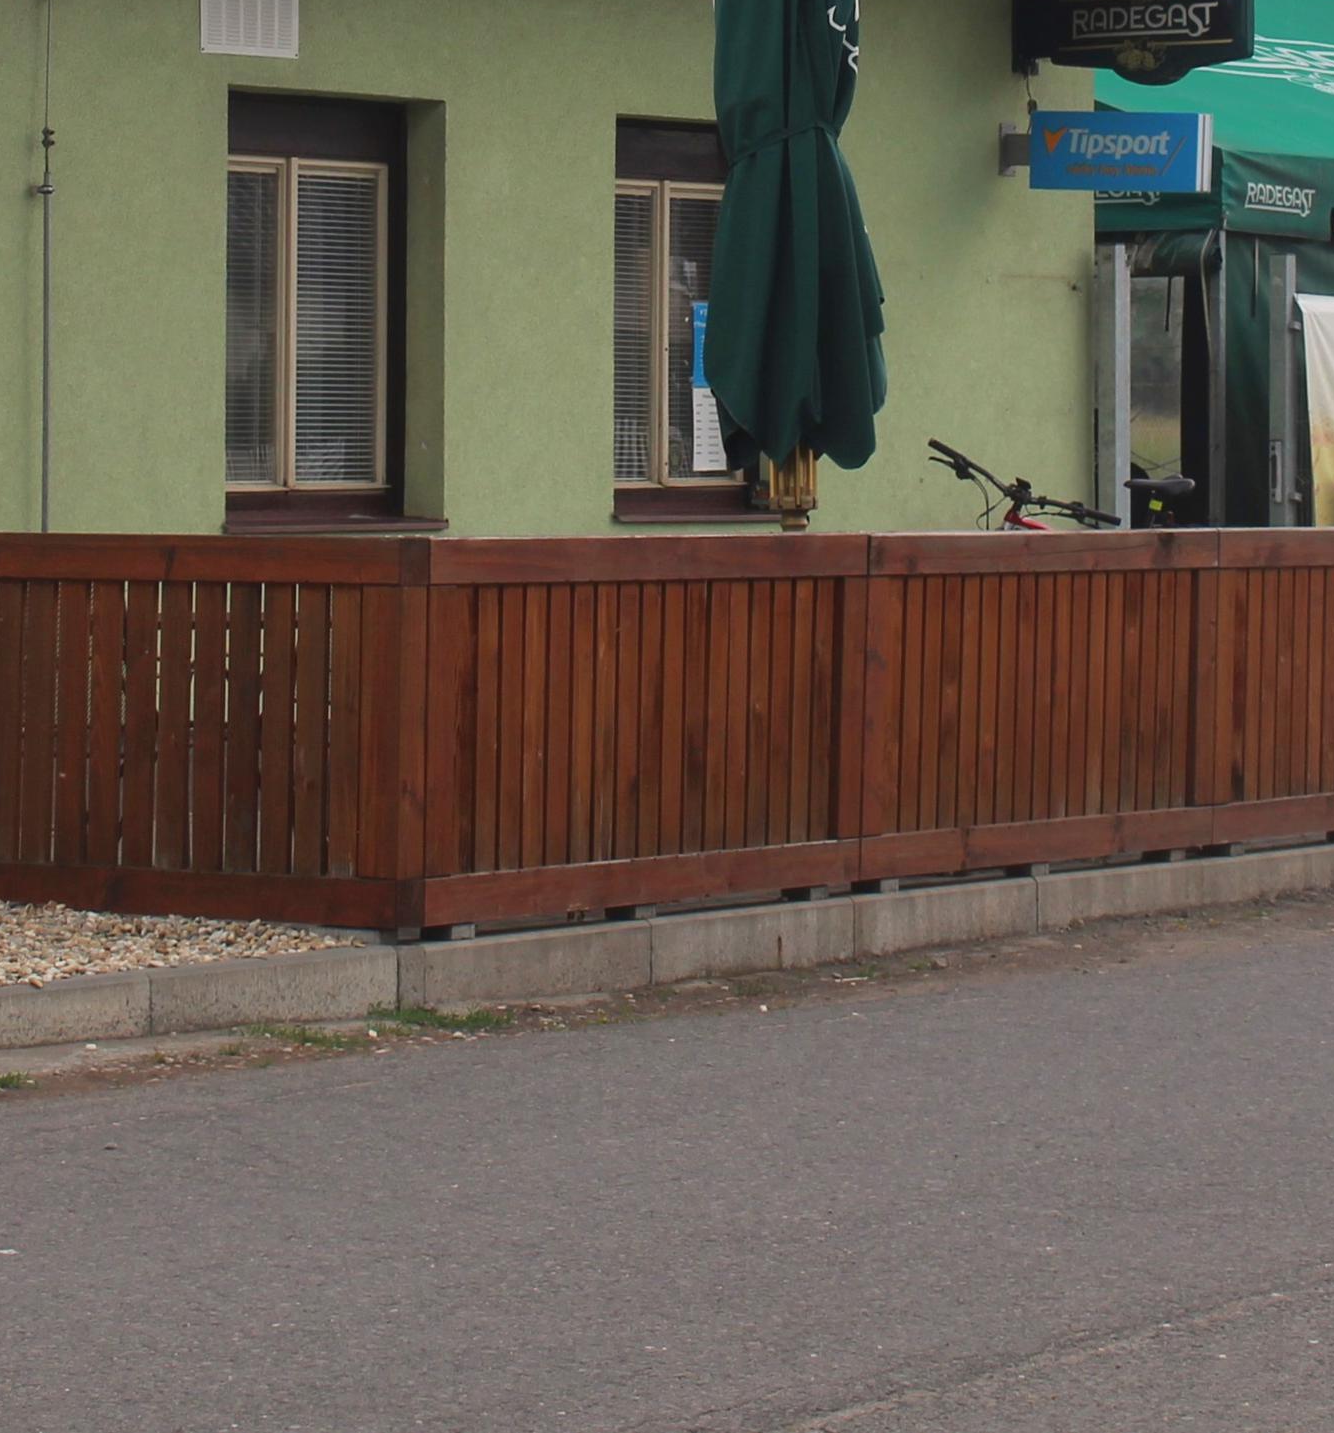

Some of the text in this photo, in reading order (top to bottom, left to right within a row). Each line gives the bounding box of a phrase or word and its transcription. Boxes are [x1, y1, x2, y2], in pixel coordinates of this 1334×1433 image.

[1071, 0, 1219, 38] RADEGAST
[1068, 128, 1171, 160] Tipsport
[1245, 182, 1316, 218] RADEGAST
